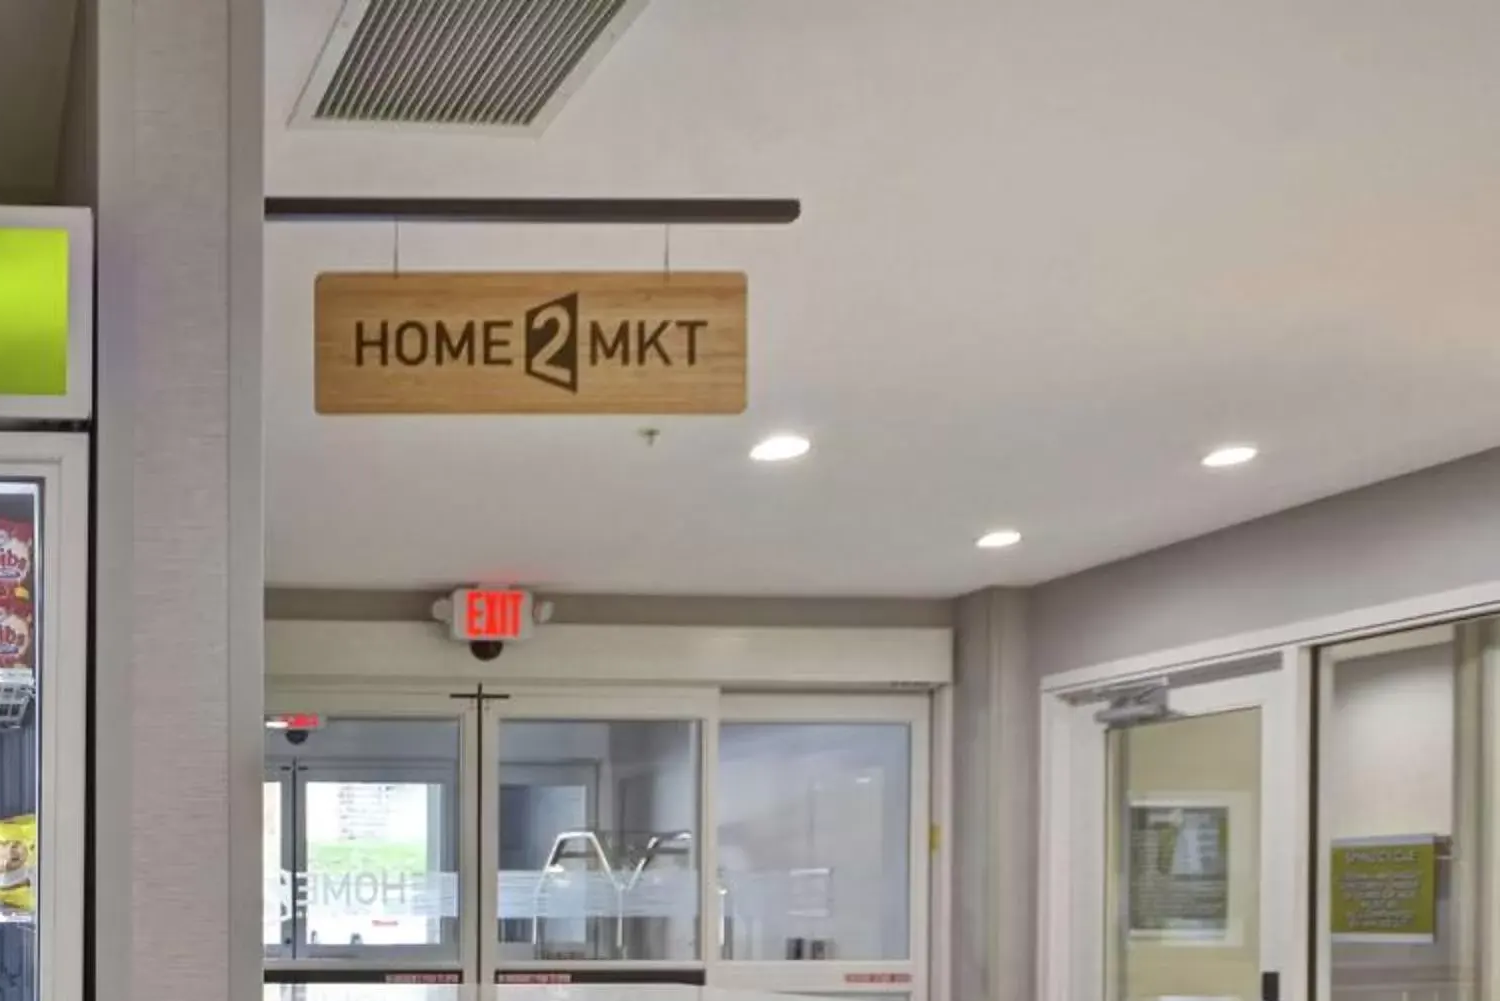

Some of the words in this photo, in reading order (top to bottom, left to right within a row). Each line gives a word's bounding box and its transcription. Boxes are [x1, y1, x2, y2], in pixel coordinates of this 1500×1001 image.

[355, 320, 514, 366] HOME
[589, 320, 708, 366] MKT
[466, 591, 524, 637] EXIT
